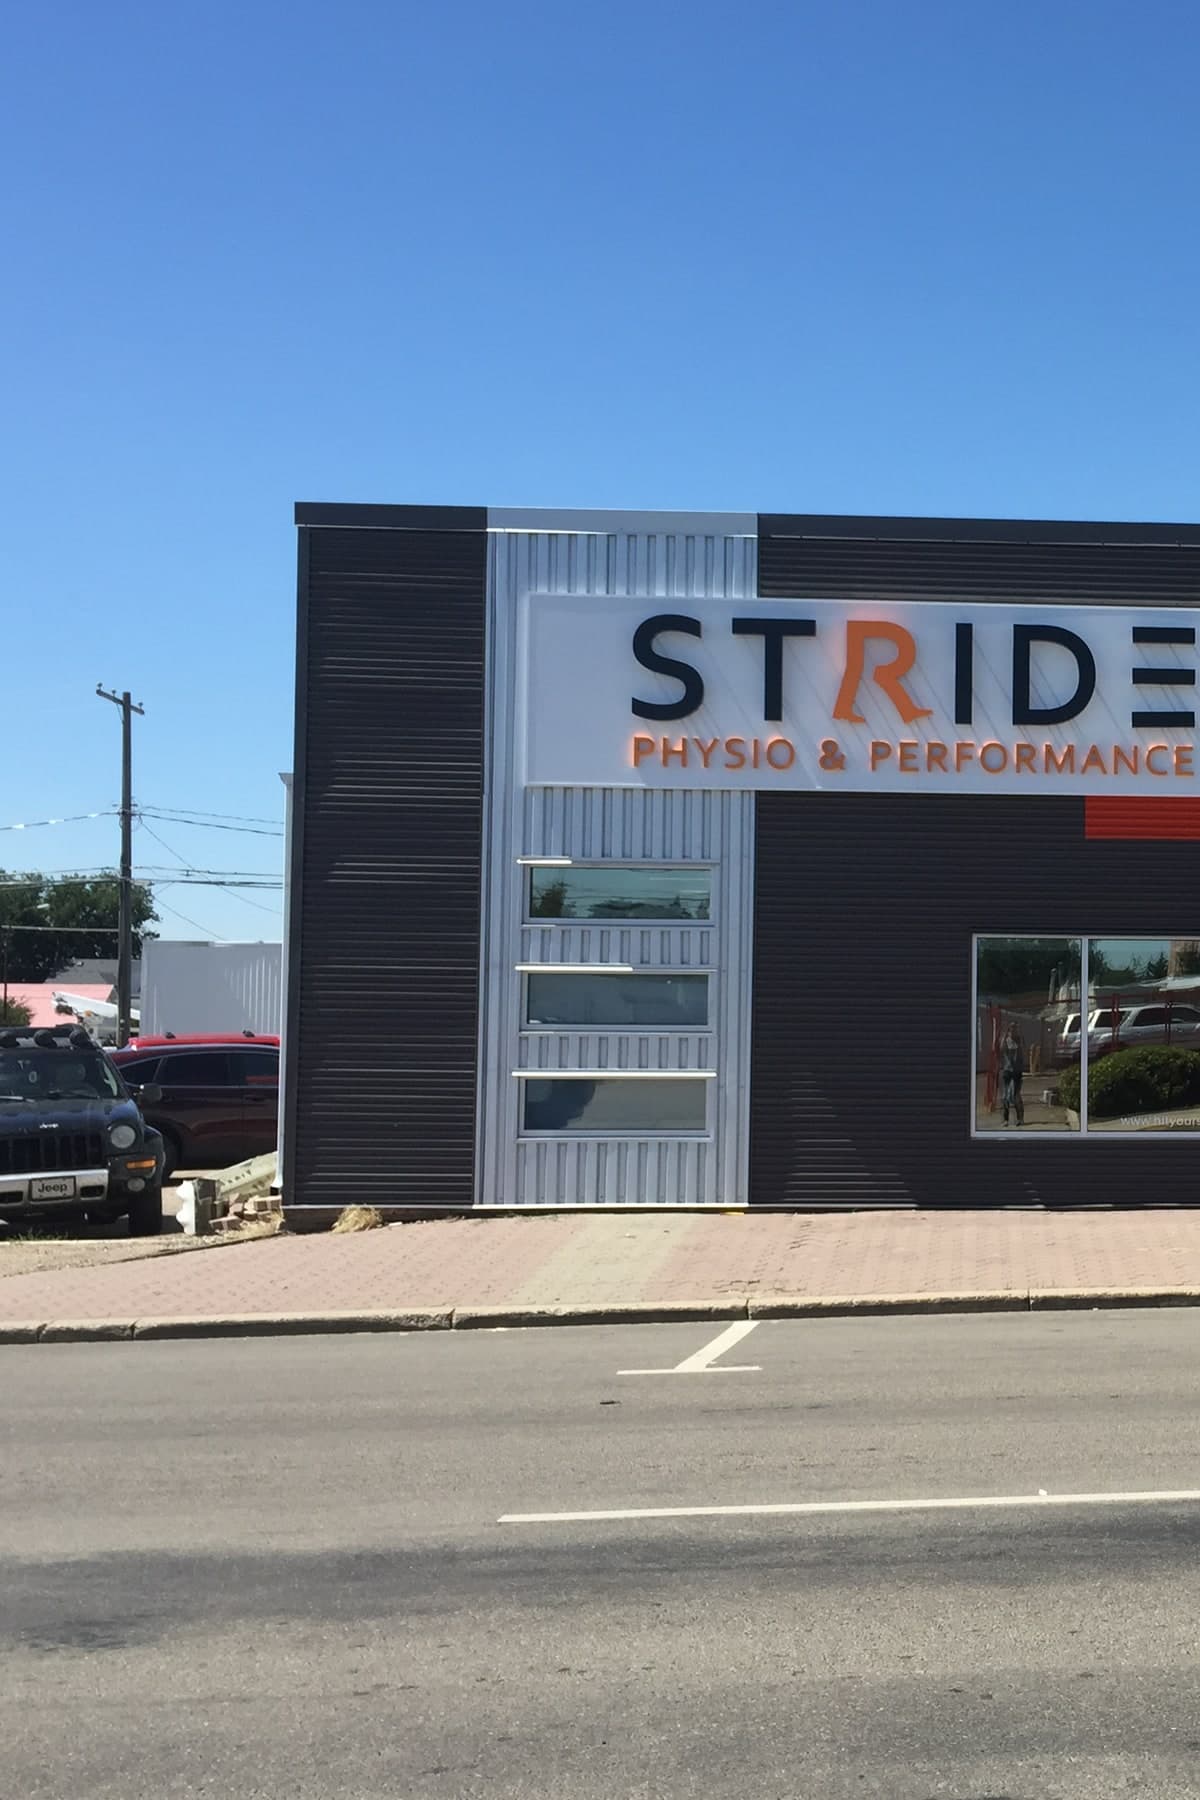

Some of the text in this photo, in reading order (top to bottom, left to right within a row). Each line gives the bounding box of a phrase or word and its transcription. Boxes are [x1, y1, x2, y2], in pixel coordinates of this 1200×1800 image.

[631, 613, 1196, 729] STRIDE
[632, 736, 1195, 777] PHYSIO & PERFORMANCE
[37, 1183, 68, 1193] Jeep
